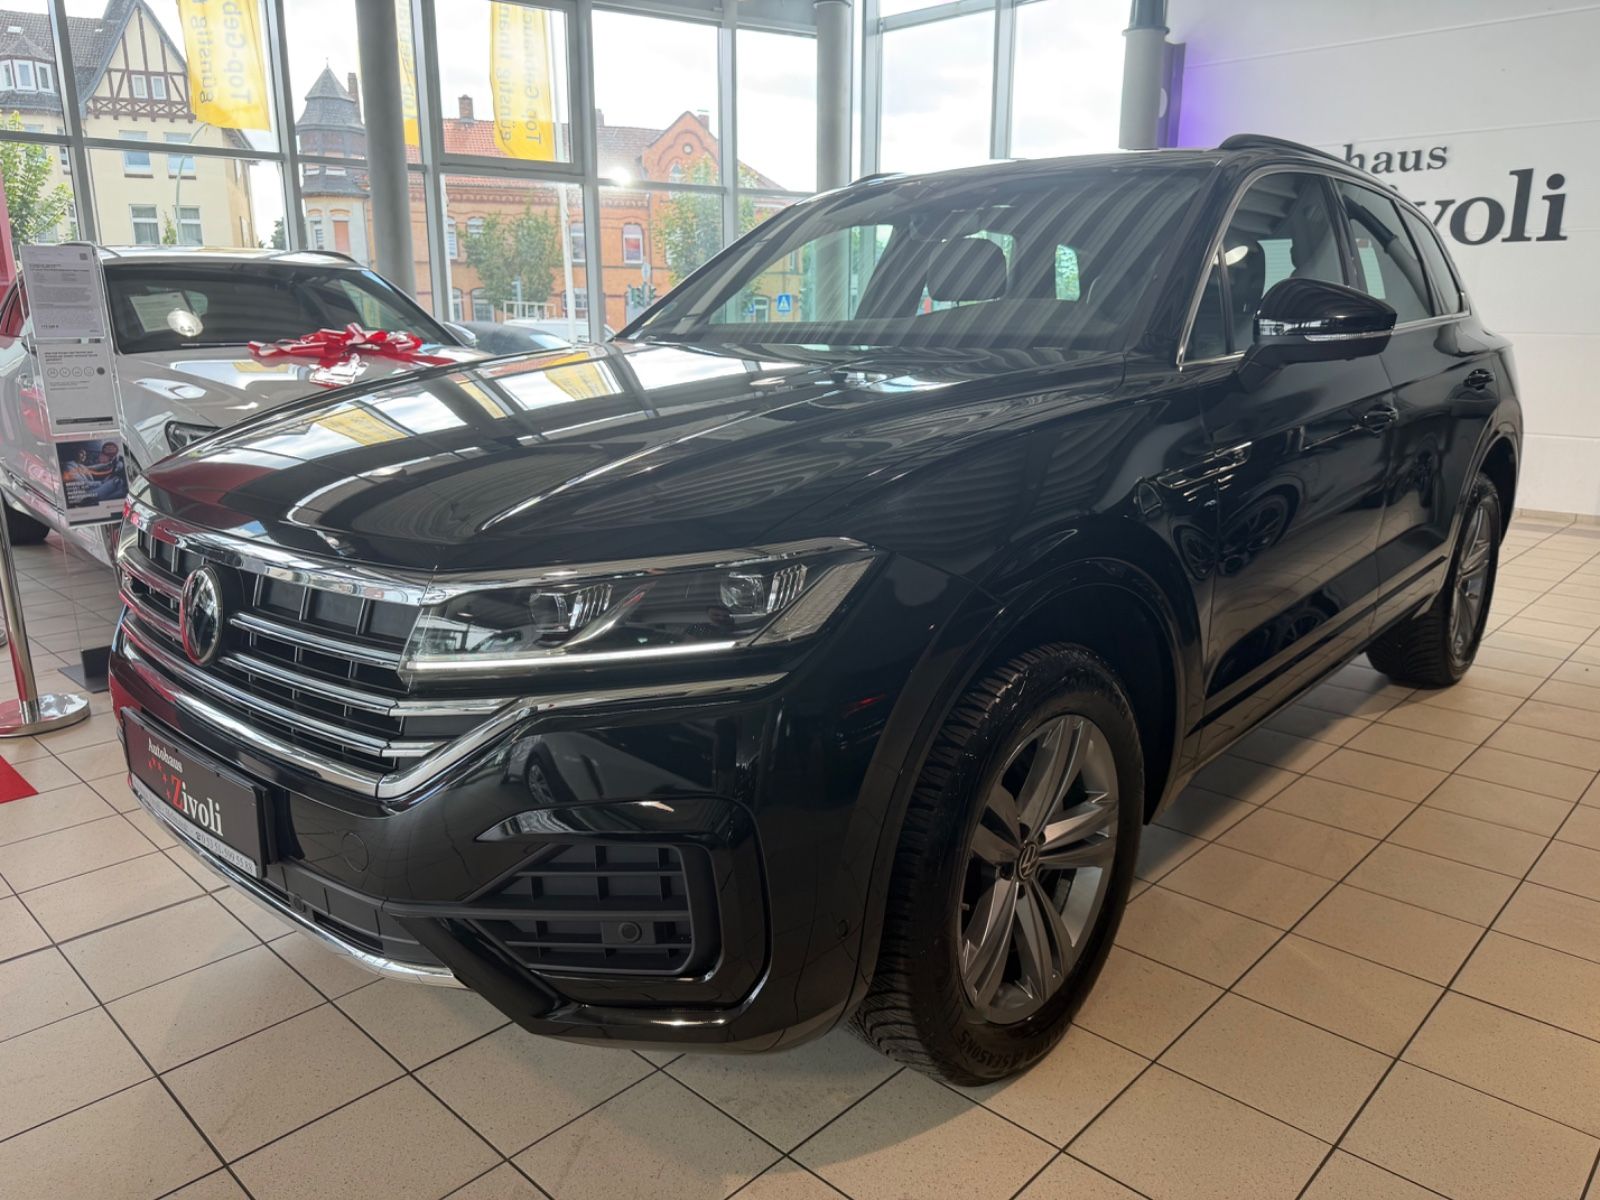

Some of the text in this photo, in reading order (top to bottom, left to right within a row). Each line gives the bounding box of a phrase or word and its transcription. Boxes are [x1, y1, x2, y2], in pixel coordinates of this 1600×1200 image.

[1390, 168, 1568, 246] voli
[148, 736, 183, 774] Autohaus
[171, 774, 224, 837] Zivoli
